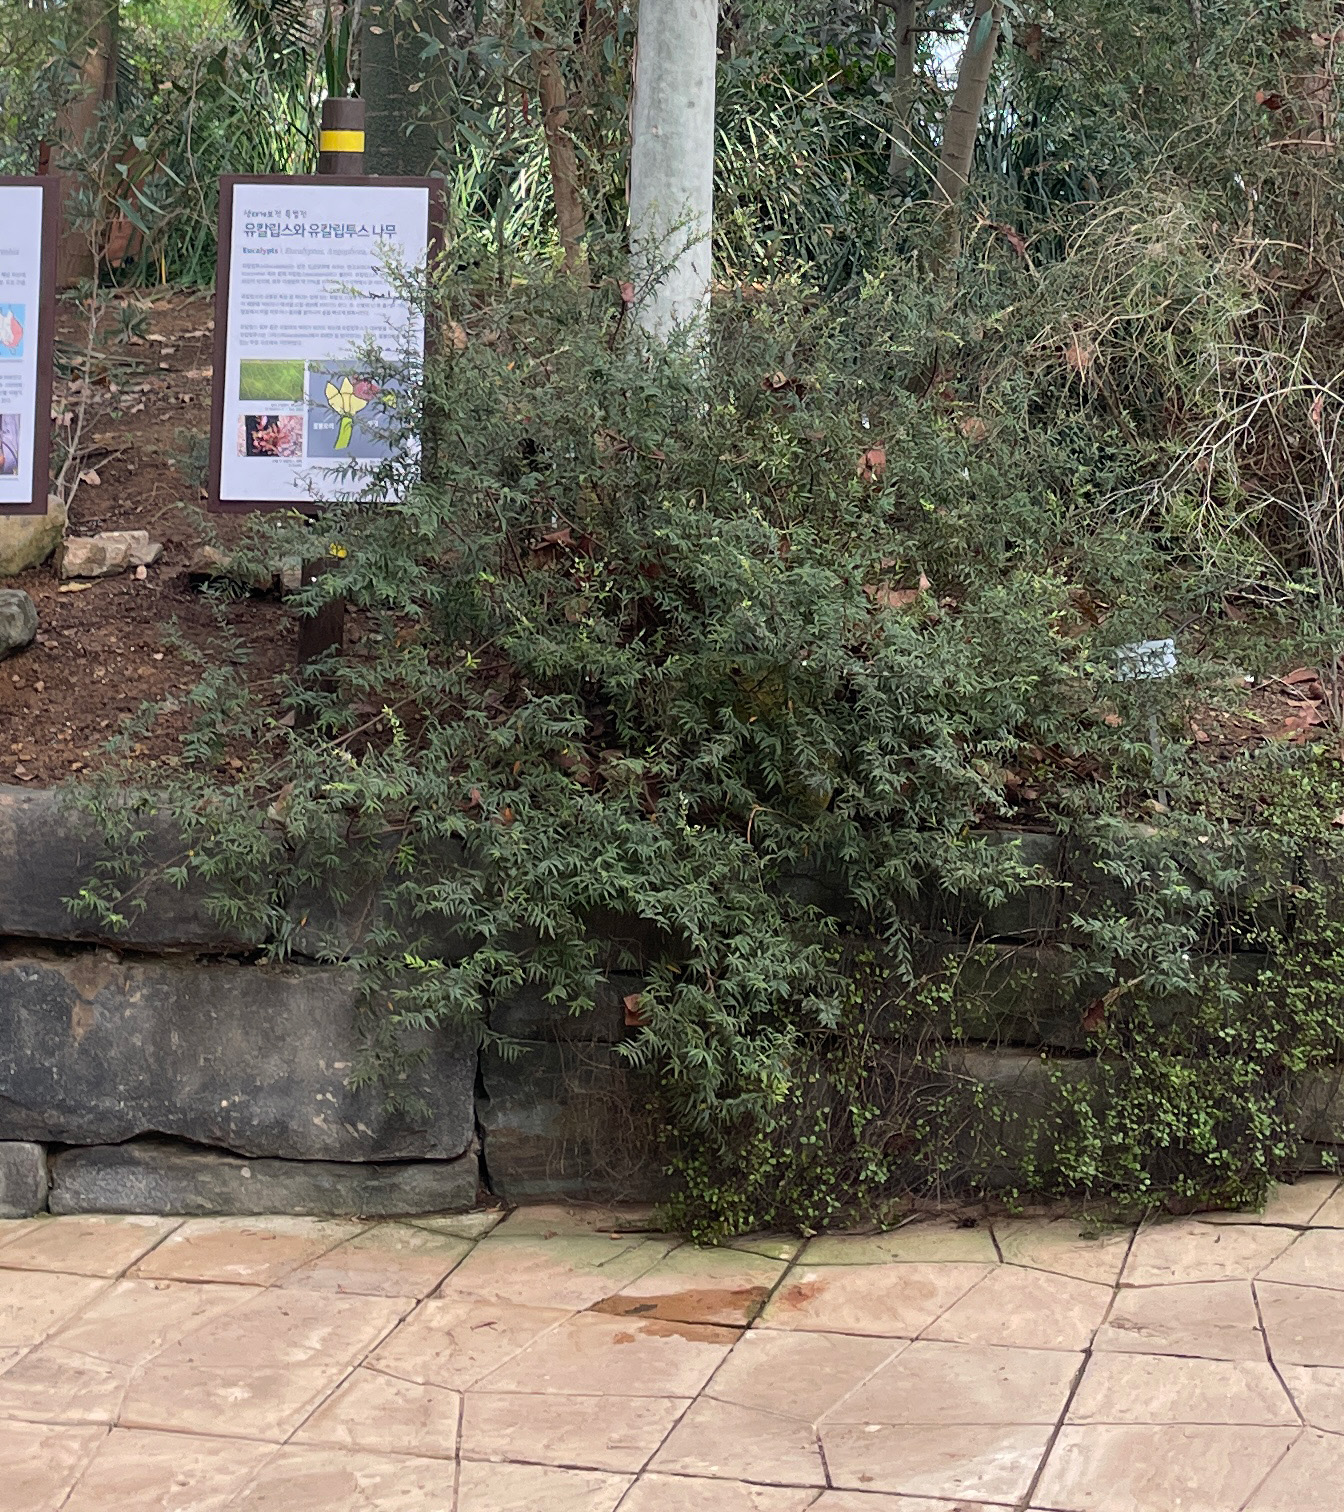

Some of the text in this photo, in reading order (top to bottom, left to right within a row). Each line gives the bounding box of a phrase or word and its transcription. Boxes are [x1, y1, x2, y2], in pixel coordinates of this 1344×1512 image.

[243, 222, 398, 239] 유칼립스와 유칼립투스 나무
[242, 247, 279, 256] Eucalypts
